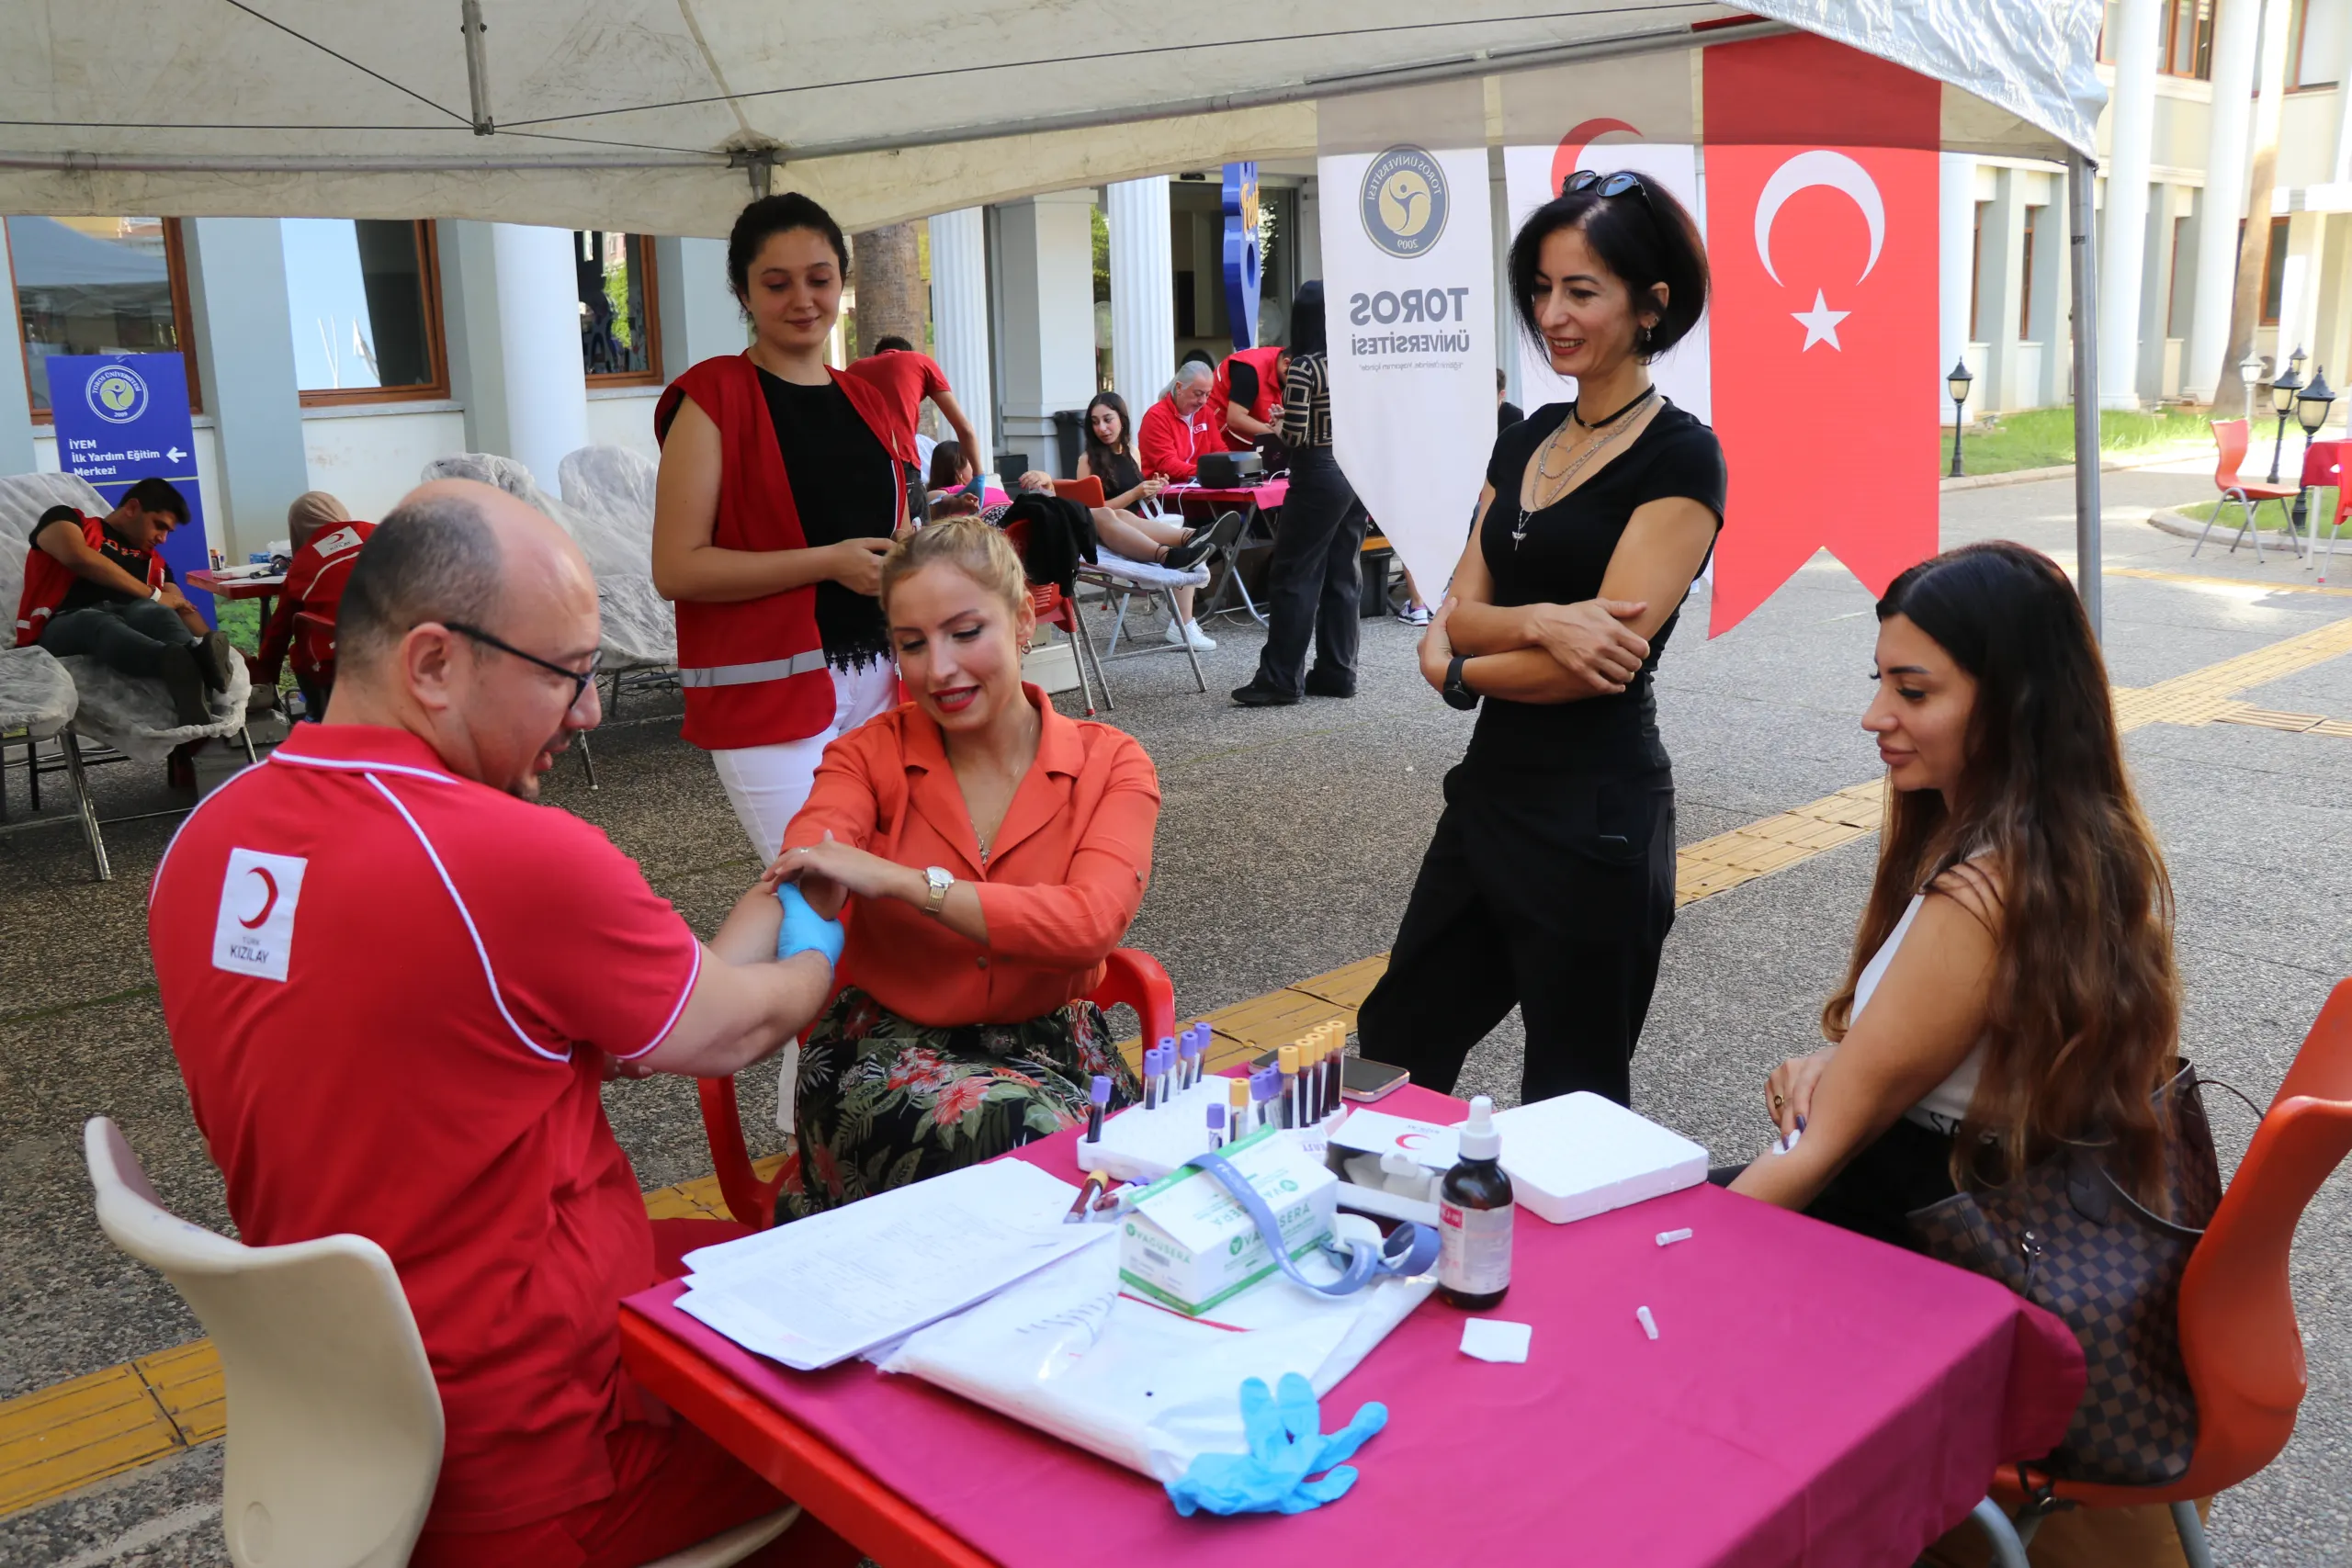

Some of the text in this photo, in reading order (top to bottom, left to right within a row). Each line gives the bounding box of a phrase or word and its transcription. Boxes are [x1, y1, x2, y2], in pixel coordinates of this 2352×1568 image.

[92, 370, 141, 394] TOROS ÜNİVERSİTESİ
[69, 438, 96, 450] İYEM
[72, 449, 161, 463] İlk Yardım Eğitim
[74, 466, 117, 477] Merkezi
[231, 945, 269, 964] KIZILAY
